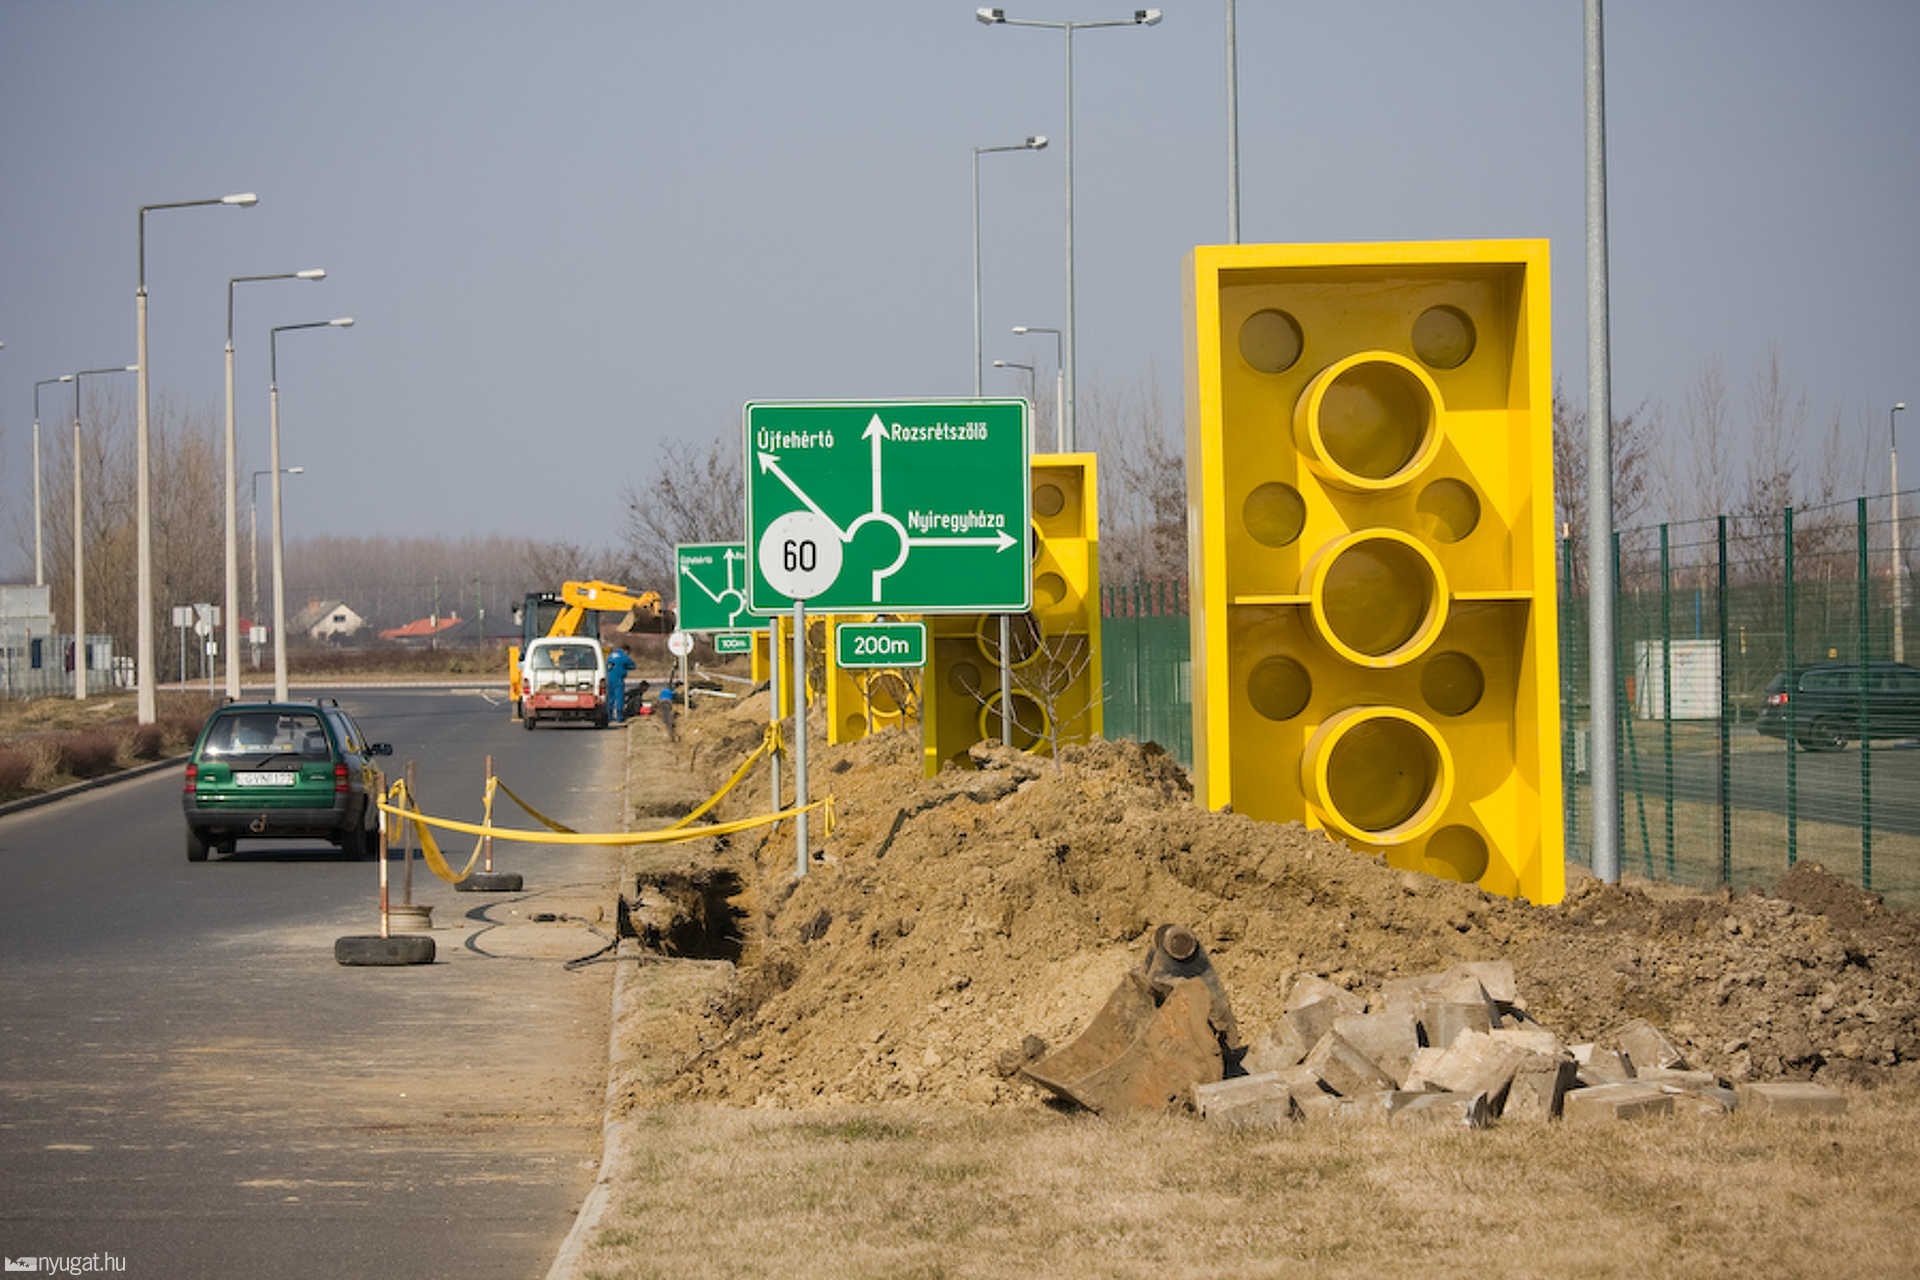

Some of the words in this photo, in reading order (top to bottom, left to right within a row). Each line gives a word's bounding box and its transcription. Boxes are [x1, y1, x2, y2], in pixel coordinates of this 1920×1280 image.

[757, 426, 834, 453] Újfehértó
[784, 539, 817, 572] 60
[853, 634, 910, 655] 200m
